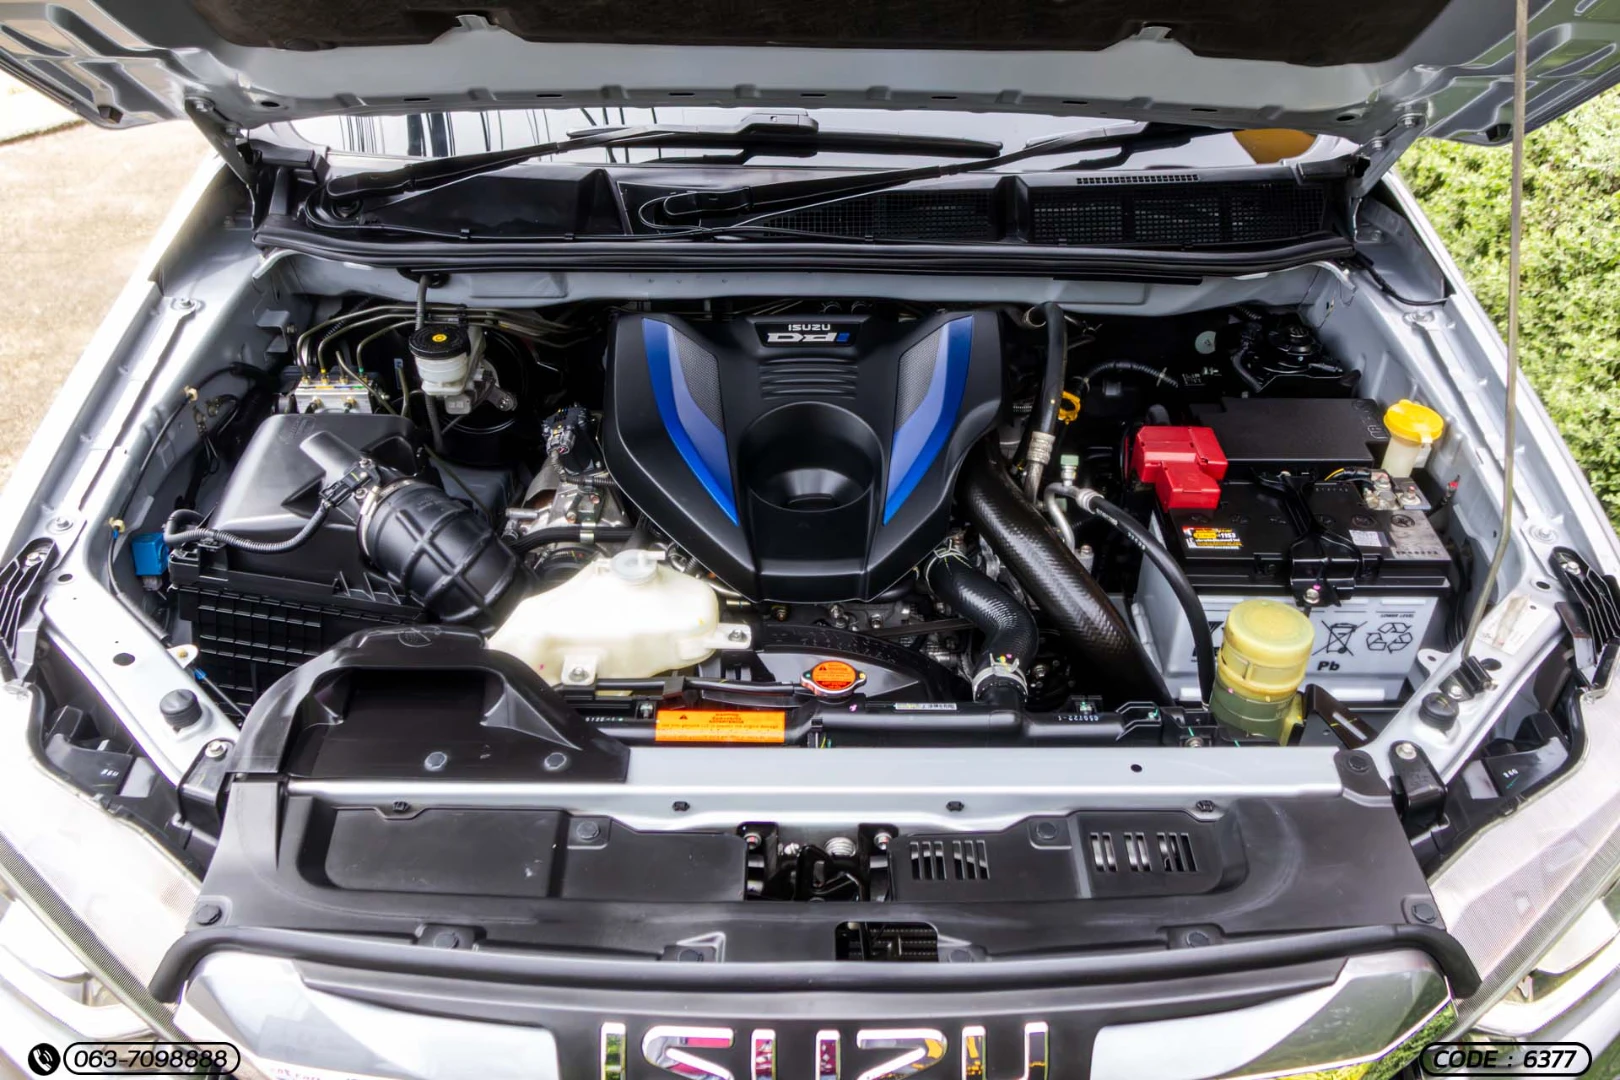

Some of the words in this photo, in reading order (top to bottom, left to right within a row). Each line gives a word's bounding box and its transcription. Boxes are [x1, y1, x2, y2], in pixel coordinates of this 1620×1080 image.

[788, 323, 831, 331] ISUZU
[1317, 660, 1340, 671] Pb
[600, 1020, 1049, 1080] ISUZU
